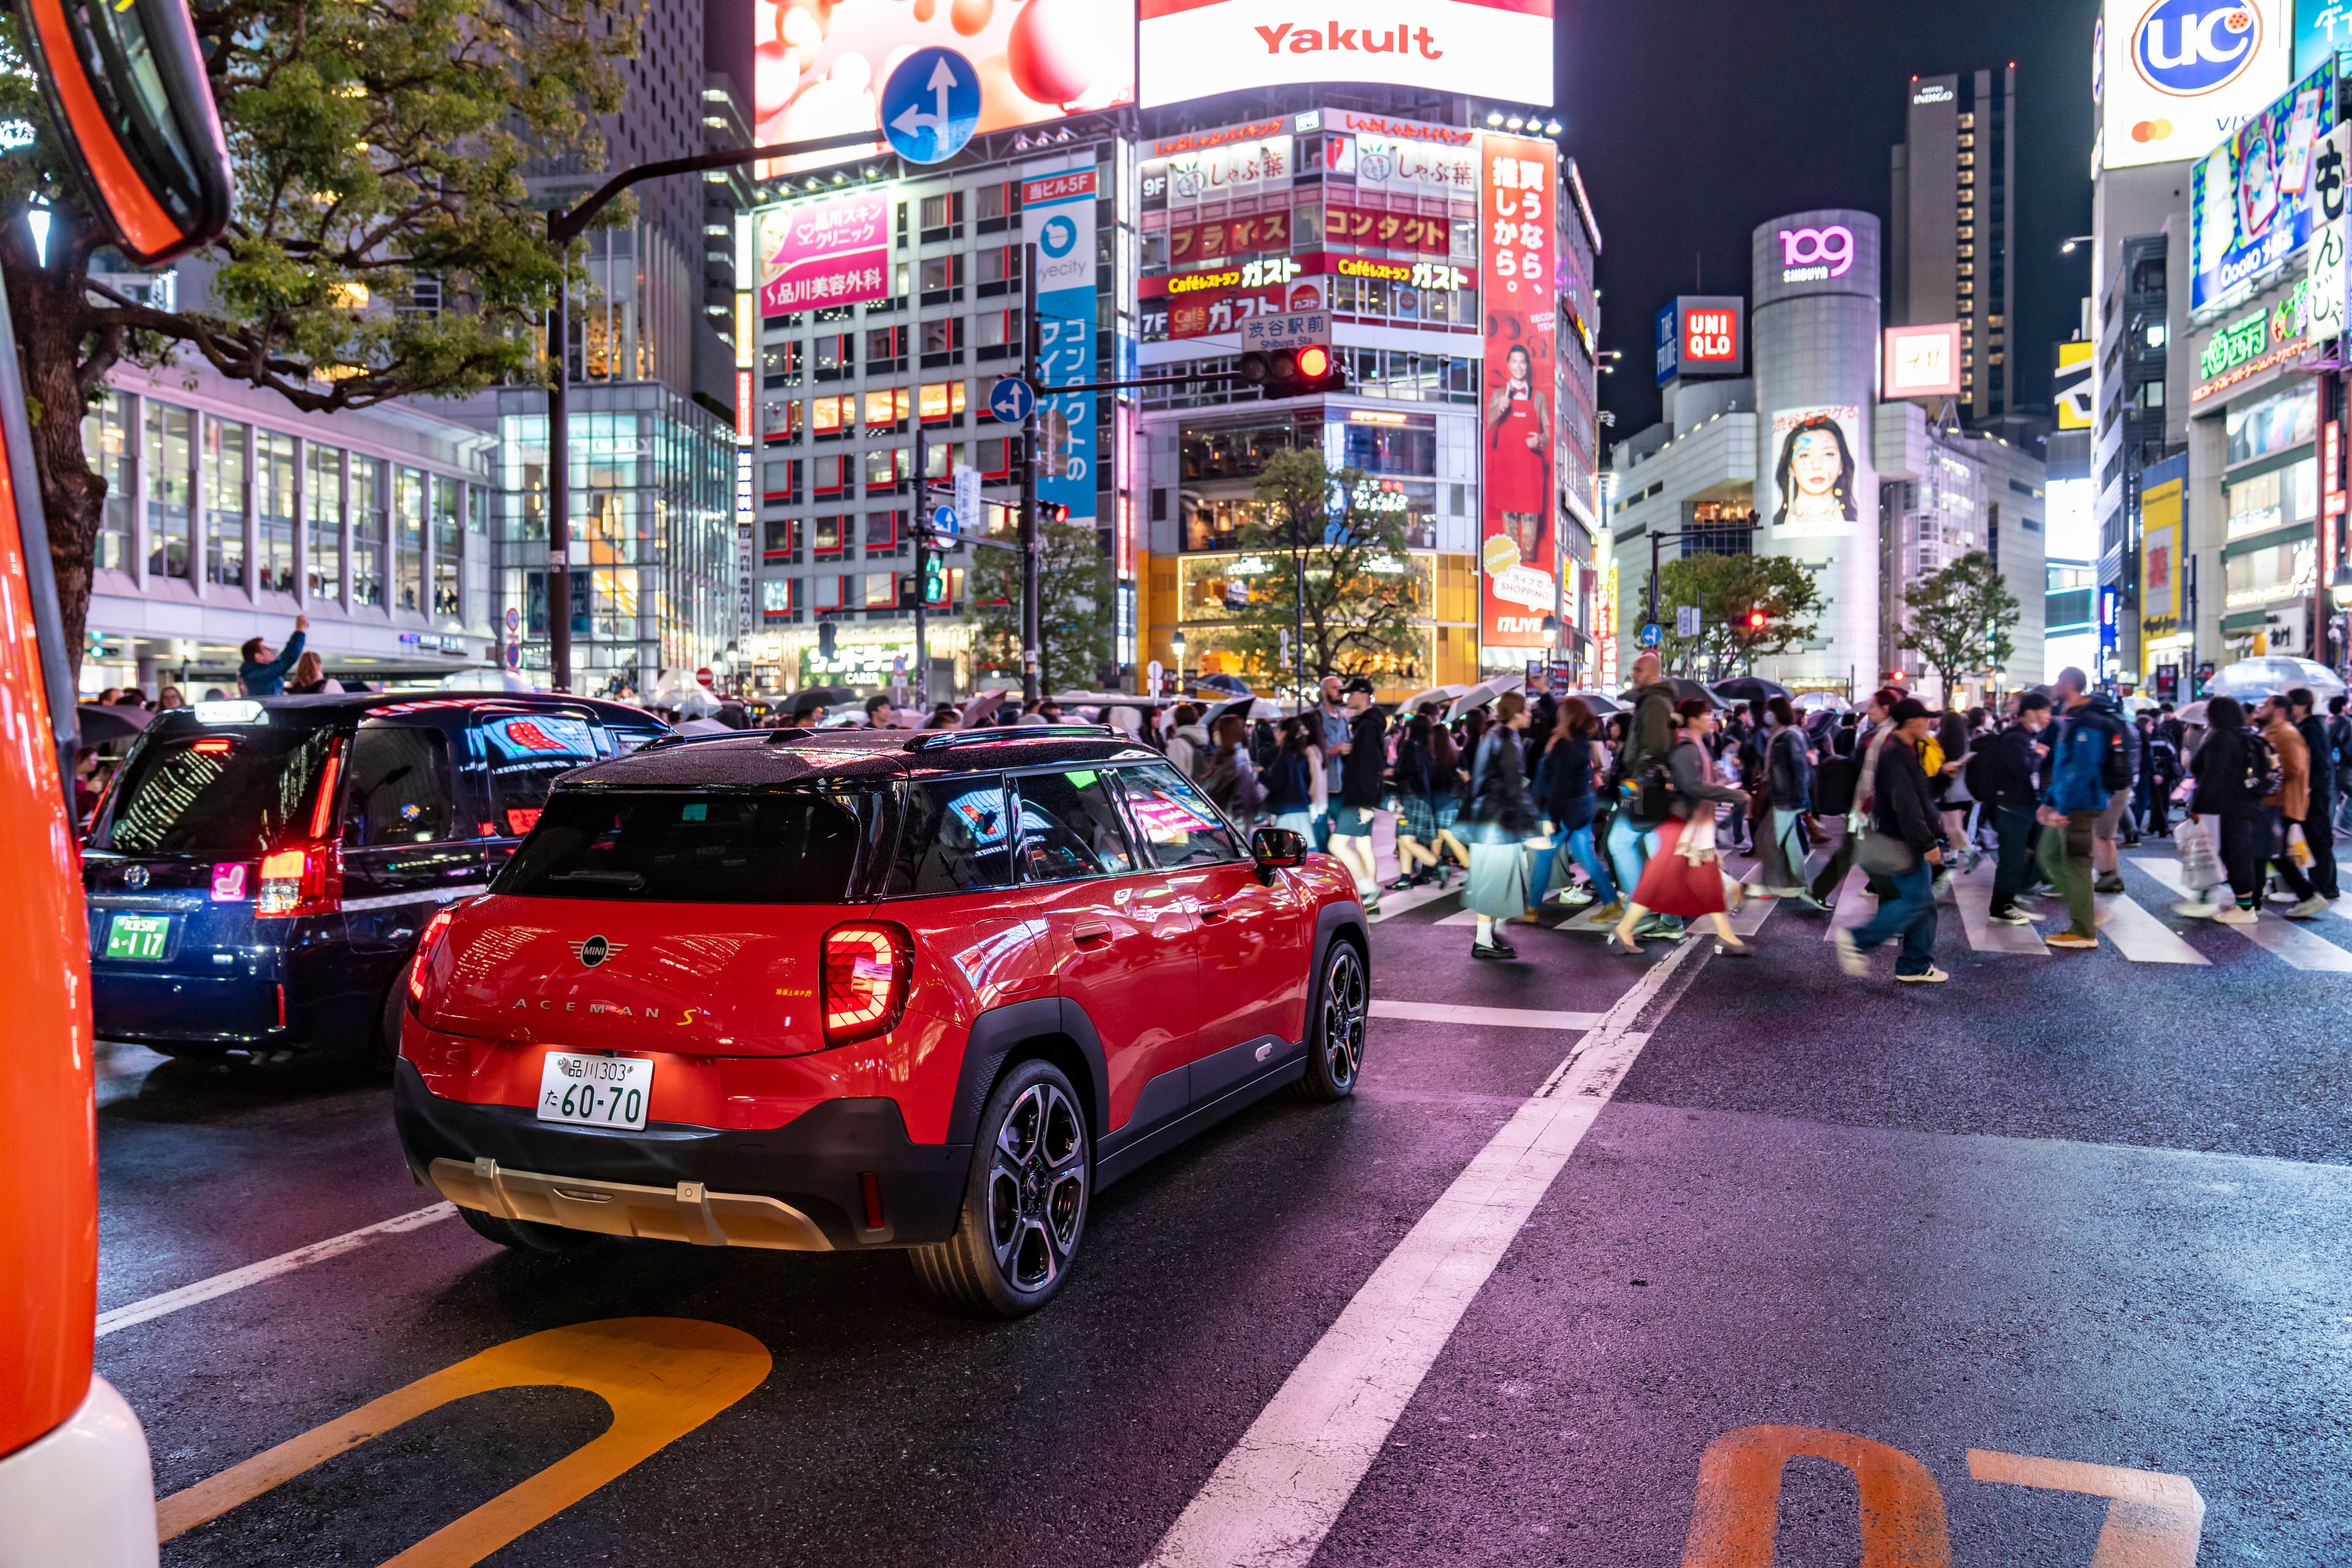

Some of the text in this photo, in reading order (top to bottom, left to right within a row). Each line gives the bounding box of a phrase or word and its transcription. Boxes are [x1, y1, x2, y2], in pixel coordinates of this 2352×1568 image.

[1254, 21, 1444, 60] Yakult
[1211, 151, 1283, 186] しゃぶ葉
[1398, 153, 1473, 186] しゃぶ葉
[1029, 175, 1088, 200] 当ビル5F
[1143, 177, 1166, 197] 9F
[815, 203, 882, 232] 品川スキン
[1326, 209, 1446, 246] コンタクト
[1493, 156, 1518, 293] 推しから。
[1519, 160, 1545, 295] 買うなら、
[815, 223, 875, 250] クリニック
[1170, 214, 1286, 256] プライス
[2315, 138, 2345, 328] もんじゃ
[1779, 225, 1855, 278] 109
[777, 266, 882, 305] 品川美容外科
[1038, 260, 1087, 283] yecity
[1242, 256, 1302, 289] ガスト
[1411, 262, 1469, 292] ガスト
[1783, 266, 1828, 283] SHIBUYA
[1142, 312, 1168, 333] 7F
[1248, 315, 1324, 339] 渋谷駅前
[1691, 314, 1727, 334] UNI
[1261, 339, 1294, 349] Shibuya
[1691, 335, 1730, 357] QLO
[1497, 616, 1543, 633] 17LIVE
[583, 946, 606, 956] MINI
[514, 998, 697, 1026] ACEMAN S
[545, 1083, 641, 1123] た 60-70
